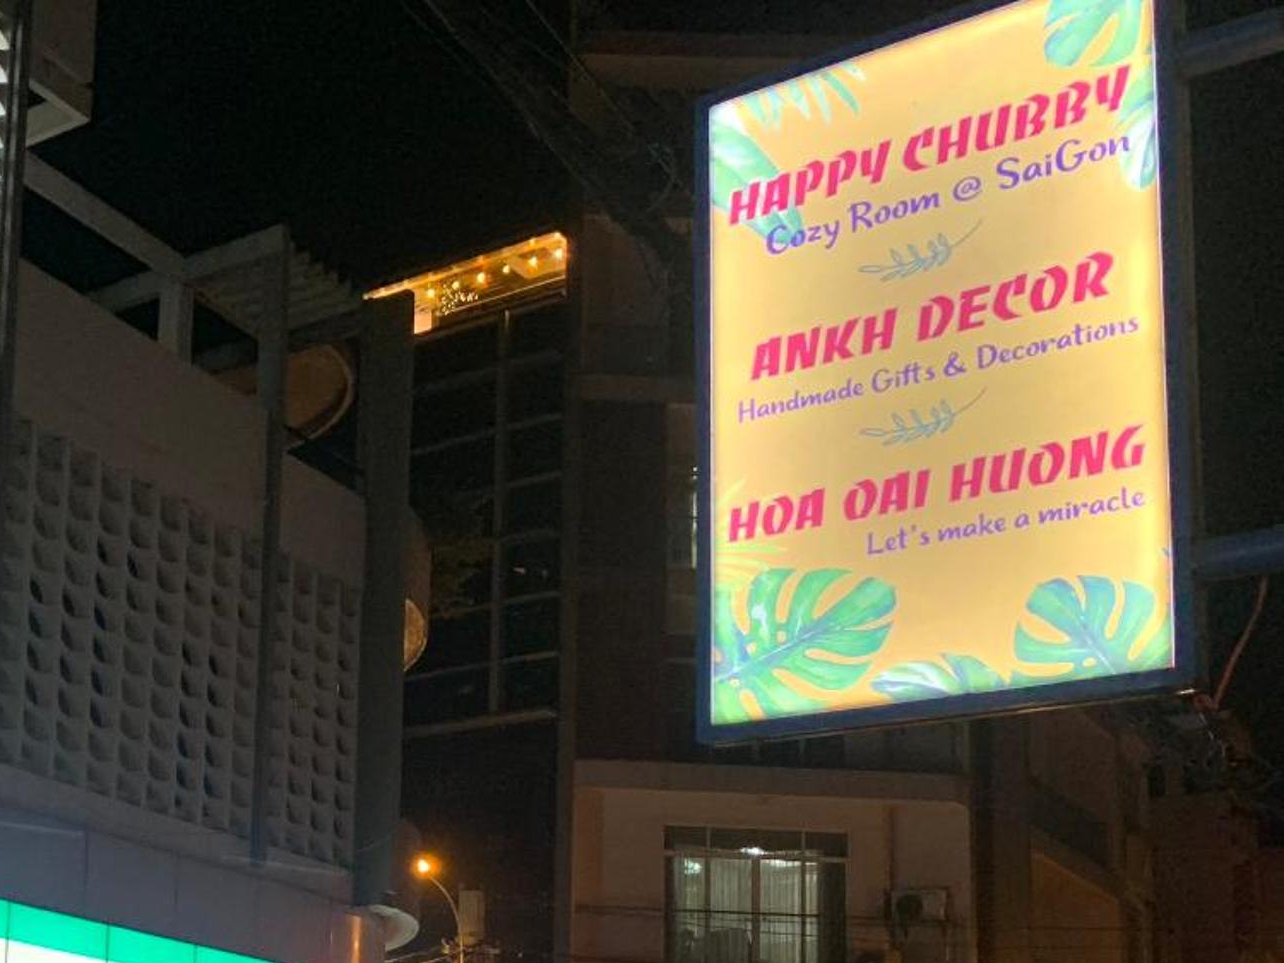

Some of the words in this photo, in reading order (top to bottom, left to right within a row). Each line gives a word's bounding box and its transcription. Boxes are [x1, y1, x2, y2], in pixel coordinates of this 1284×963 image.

[729, 140, 891, 225] HAPPY
[903, 65, 1130, 171] CHUBBY
[766, 220, 840, 254] Cozy
[848, 192, 940, 232] Room
[953, 176, 982, 201] @
[996, 136, 1130, 189] SaiGon
[738, 379, 864, 423] Handmade
[871, 362, 935, 393] Gifts
[943, 352, 966, 376] &
[977, 317, 1139, 369] Decorations
[751, 308, 898, 380] ANKH
[917, 252, 1114, 341] DECOR
[729, 488, 825, 542] HOA
[843, 469, 931, 520] OAI
[949, 424, 1145, 502] HUONG
[867, 525, 930, 554] Let's
[938, 513, 1006, 542] make
[1014, 513, 1030, 528] a
[1038, 487, 1145, 525] miracle
